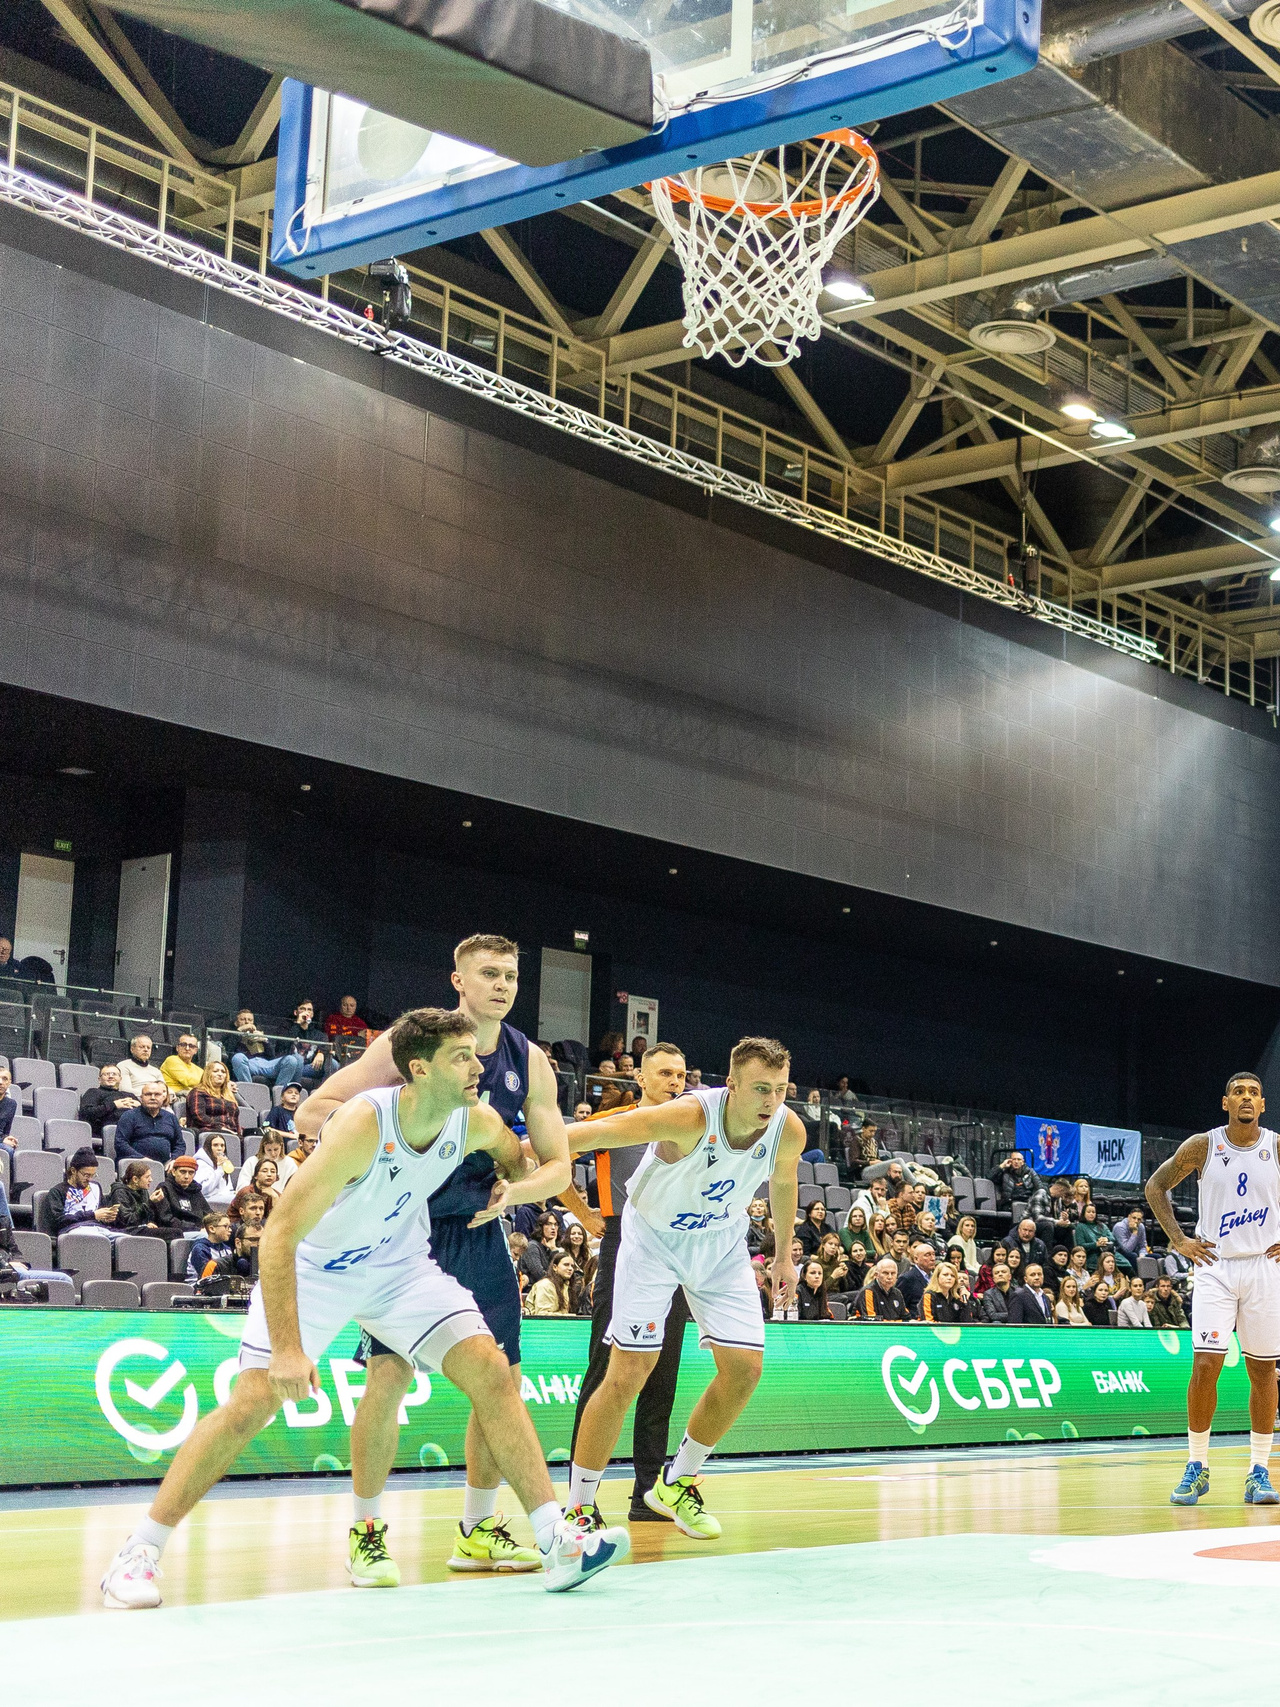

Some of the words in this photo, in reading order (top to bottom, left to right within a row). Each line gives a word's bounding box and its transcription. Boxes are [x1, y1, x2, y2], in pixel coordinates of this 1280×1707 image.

[701, 1179, 736, 1203] 12
[1236, 1172, 1248, 1197] 8
[384, 1191, 411, 1222] 2
[1219, 1206, 1269, 1238] Enisey
[520, 1374, 582, 1404] АНК
[943, 1358, 1062, 1411] СБЕР
[1091, 1370, 1151, 1394] БАНК
